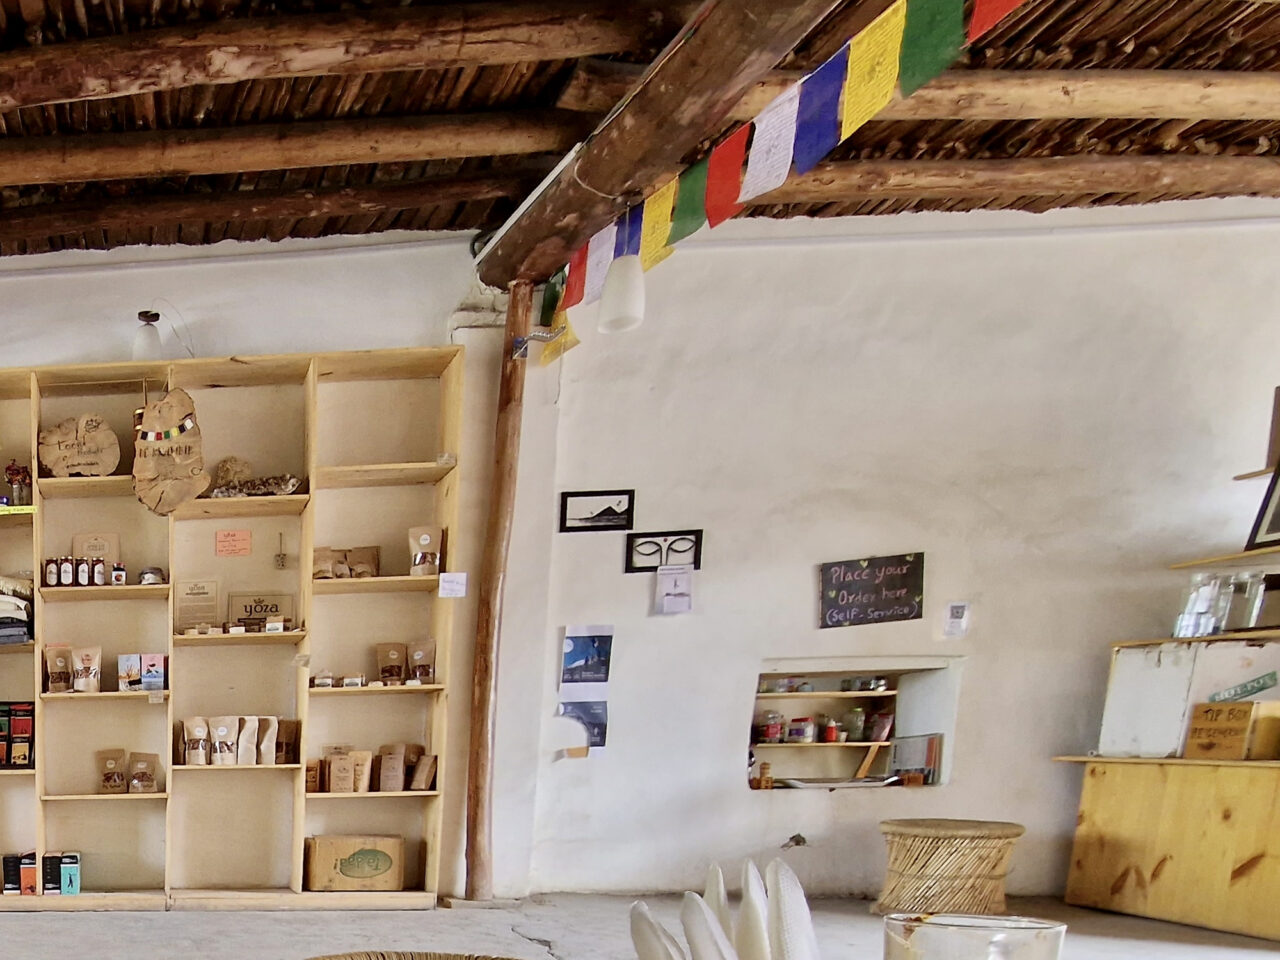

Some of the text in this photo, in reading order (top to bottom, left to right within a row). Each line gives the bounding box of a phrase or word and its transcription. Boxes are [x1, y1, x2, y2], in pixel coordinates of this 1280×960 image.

[830, 563, 911, 584] Place your
[838, 587, 908, 605] Order here
